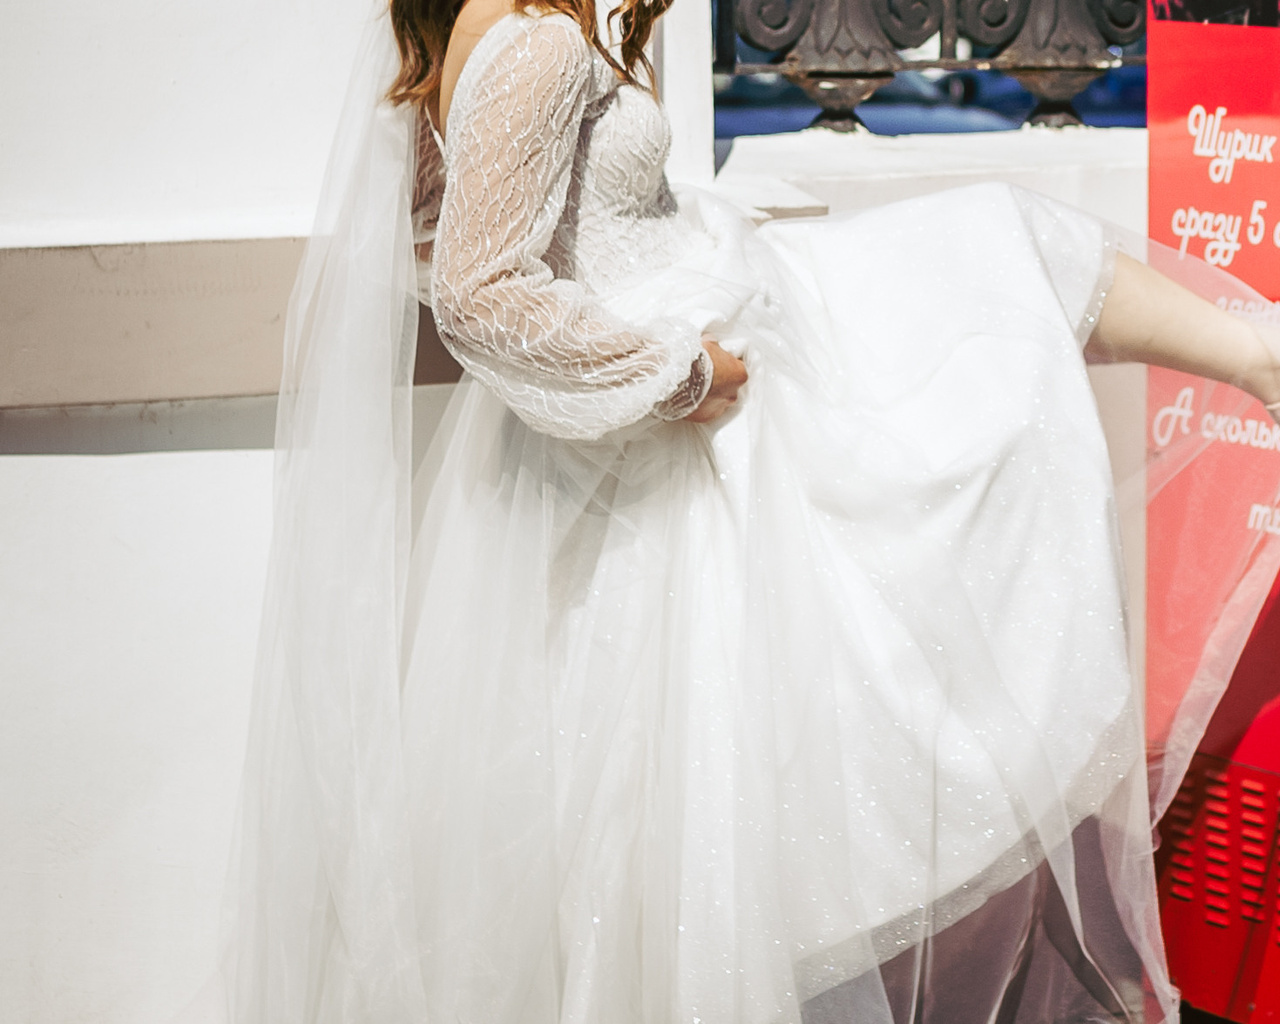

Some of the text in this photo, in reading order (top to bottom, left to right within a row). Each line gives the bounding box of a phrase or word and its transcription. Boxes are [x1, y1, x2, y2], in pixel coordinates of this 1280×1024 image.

[1187, 105, 1277, 183] Шурик
[1171, 206, 1242, 267] сразу
[1247, 200, 1267, 245] 5
[1152, 387, 1195, 446] А
